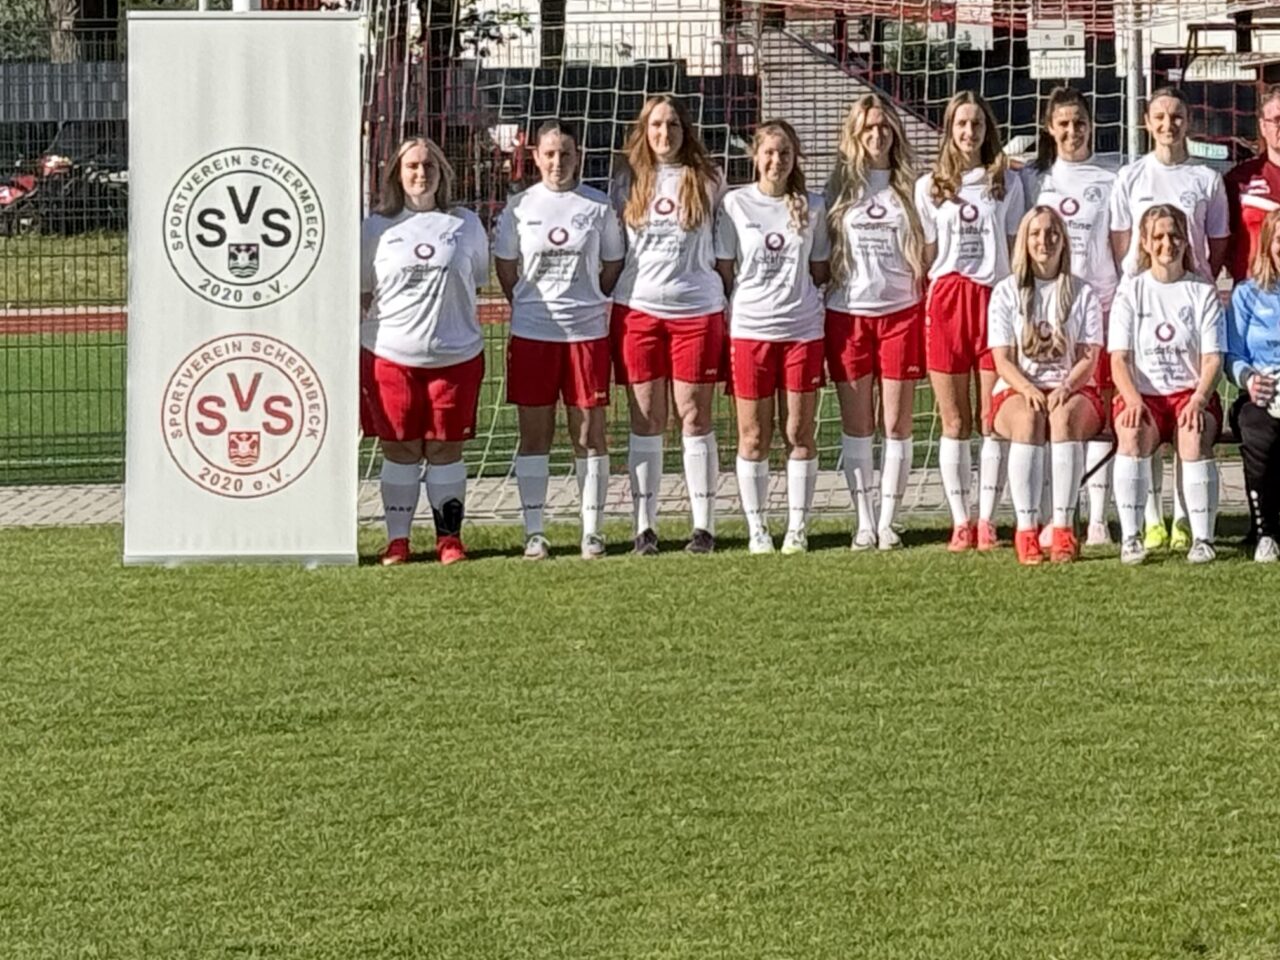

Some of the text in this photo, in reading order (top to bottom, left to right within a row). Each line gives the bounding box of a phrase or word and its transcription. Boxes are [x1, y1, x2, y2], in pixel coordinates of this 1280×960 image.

[170, 155, 318, 252] SPORTVEREIN SCHERMBECK
[196, 186, 292, 247] SVS
[198, 278, 242, 302] 2020
[169, 341, 320, 440] SPORTVEREIN SCHERMBECK
[196, 373, 294, 436] SVS
[199, 467, 243, 491] 2020
